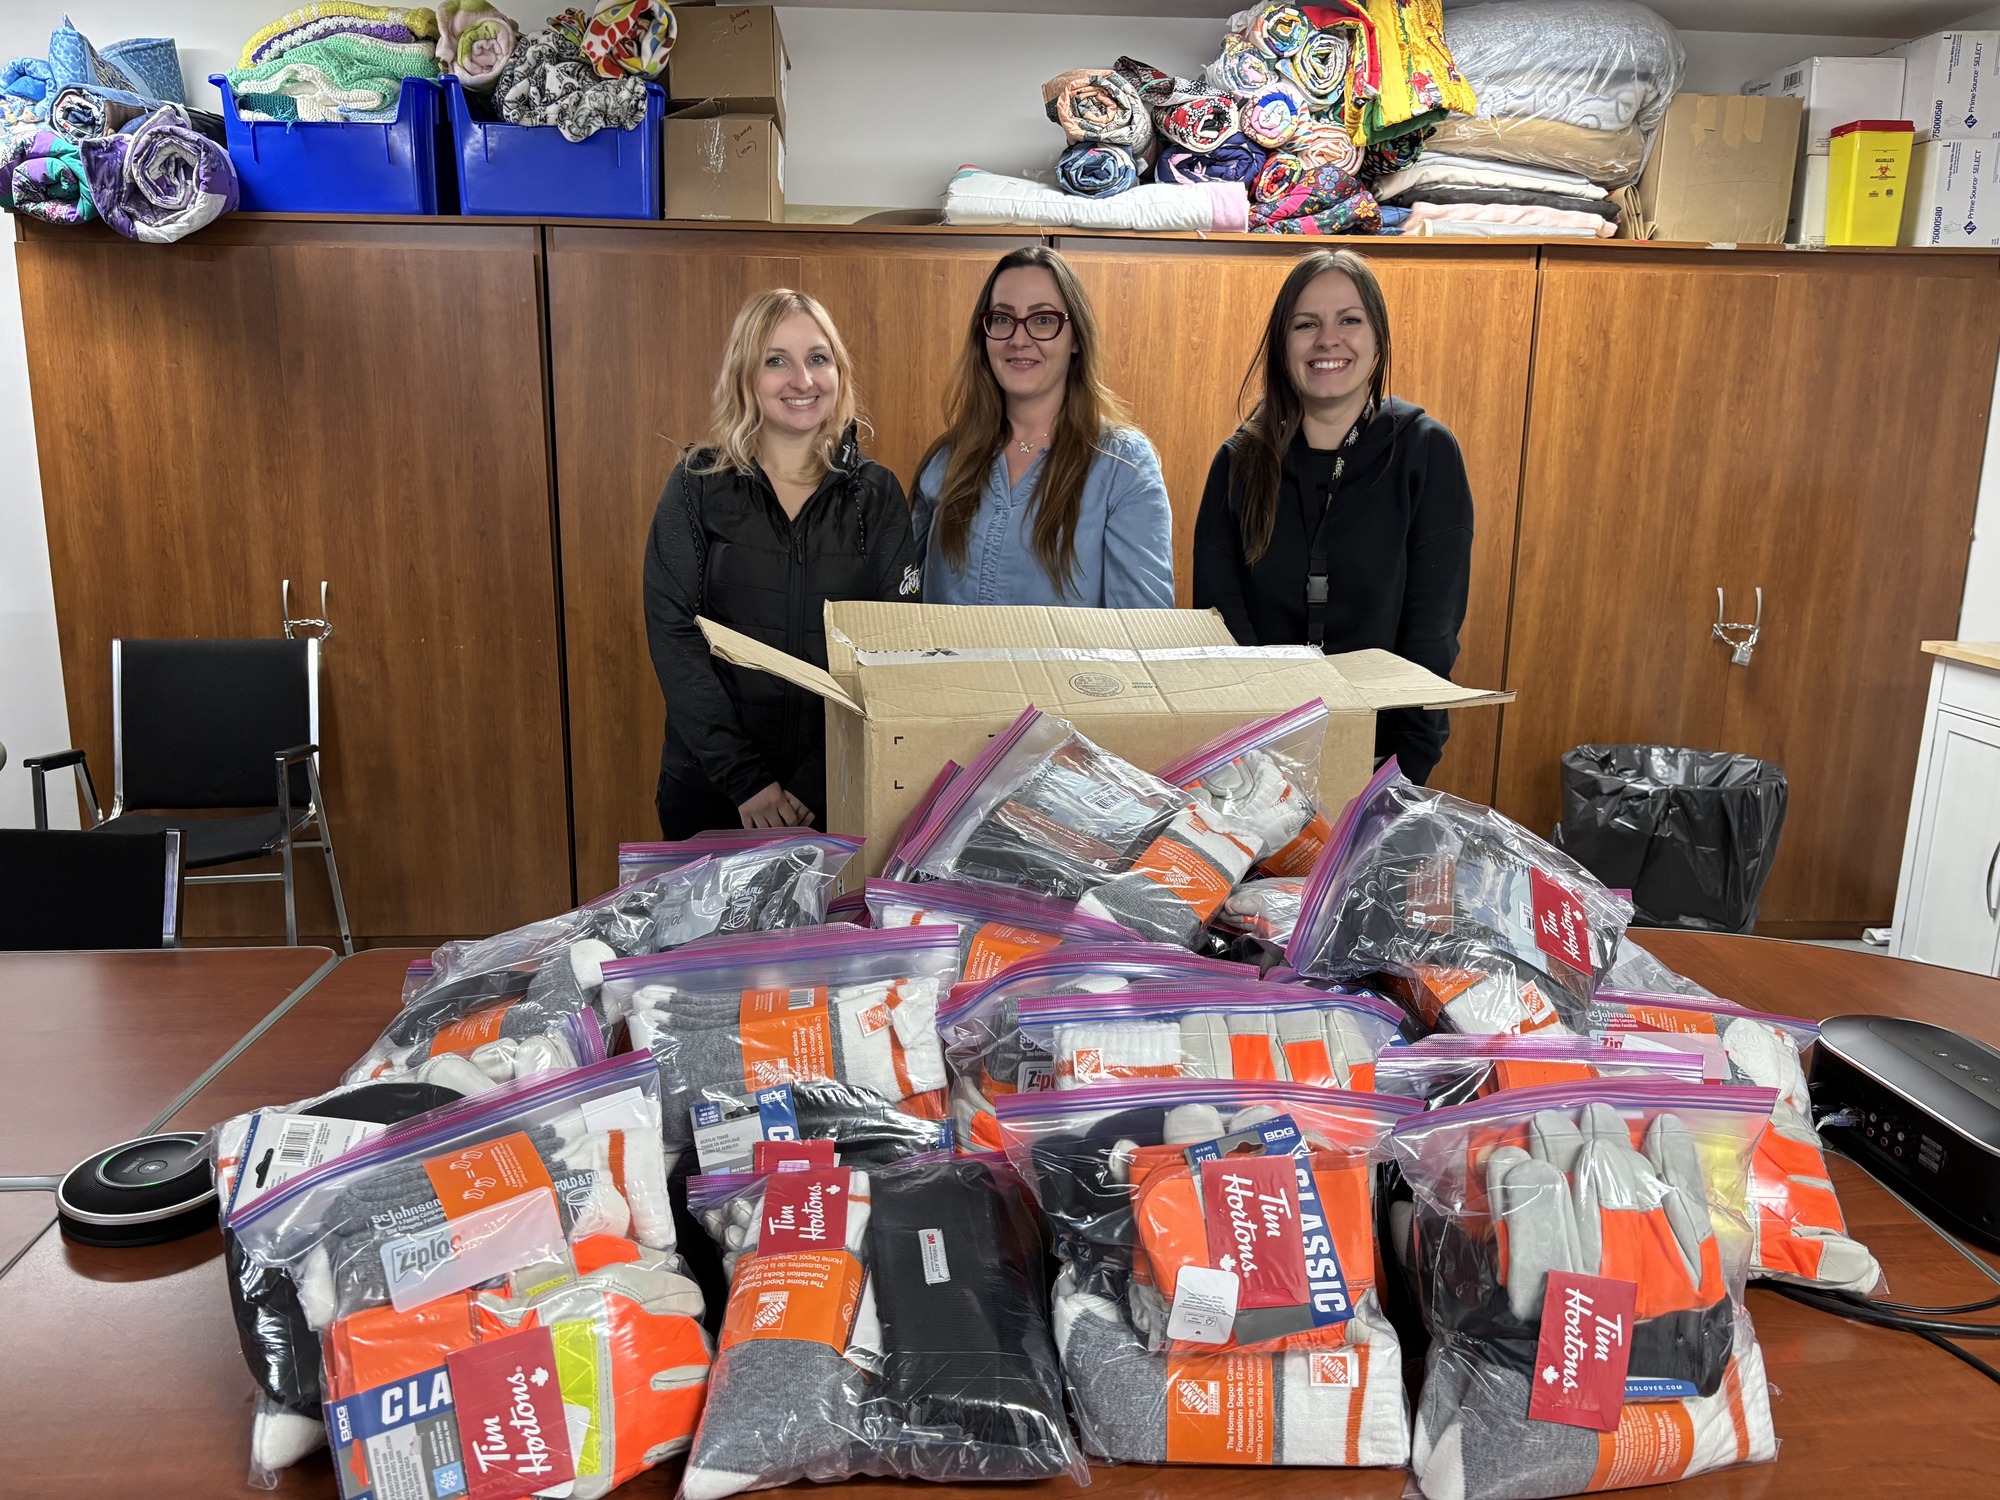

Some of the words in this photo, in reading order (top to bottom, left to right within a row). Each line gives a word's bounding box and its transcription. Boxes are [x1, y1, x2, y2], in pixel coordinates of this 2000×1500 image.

[1974, 42, 1982, 66] SELECT
[1932, 100, 1944, 138] 75000580
[1973, 150, 1982, 174] SELECT
[1932, 206, 1943, 244] 75000580
[1540, 910, 1560, 938] Tim
[1561, 900, 1582, 962] Hortons
[754, 1062, 780, 1084] HOME
[1077, 1050, 1100, 1074] HOME
[760, 1090, 787, 1100] BDG
[1264, 1127, 1295, 1140] BDG
[768, 1204, 796, 1236] Tim
[798, 1185, 827, 1240] Hortons
[1222, 1173, 1258, 1271] Hortons
[1258, 1188, 1292, 1238] Tim
[926, 1234, 936, 1244] 3M
[396, 1234, 462, 1274] Ziploc
[788, 1262, 830, 1270] Chaussettes
[822, 1255, 843, 1264] Home
[763, 1270, 786, 1278] Socks
[763, 1278, 784, 1286] Depot
[786, 1278, 808, 1286] Home
[787, 1270, 828, 1281] Foundation
[810, 1280, 824, 1288] The
[753, 1300, 787, 1330] HOME
[755, 1301, 775, 1319] DEPOT
[767, 1314, 781, 1326] THE
[1562, 1287, 1594, 1389] Hortons
[1594, 1313, 1622, 1362] Tim
[1236, 1372, 1244, 1380] (2
[1321, 1355, 1349, 1384] HOME
[1322, 1366, 1339, 1384] DEPOT
[1334, 1358, 1346, 1370] THE
[1178, 1380, 1209, 1414] HOME
[1190, 1380, 1208, 1400] DEPOT
[1226, 1382, 1235, 1408] Depot
[1236, 1381, 1244, 1407] Socks
[1247, 1396, 1254, 1406] de
[1181, 1397, 1194, 1410] THE
[336, 1406, 350, 1442] BDG
[506, 1372, 553, 1476] Hortons
[1226, 1410, 1234, 1434] Home
[1236, 1409, 1244, 1452] Foundation
[1246, 1408, 1254, 1453] Chaussettes
[1256, 1420, 1264, 1442] Depot
[472, 1415, 511, 1474] Tim
